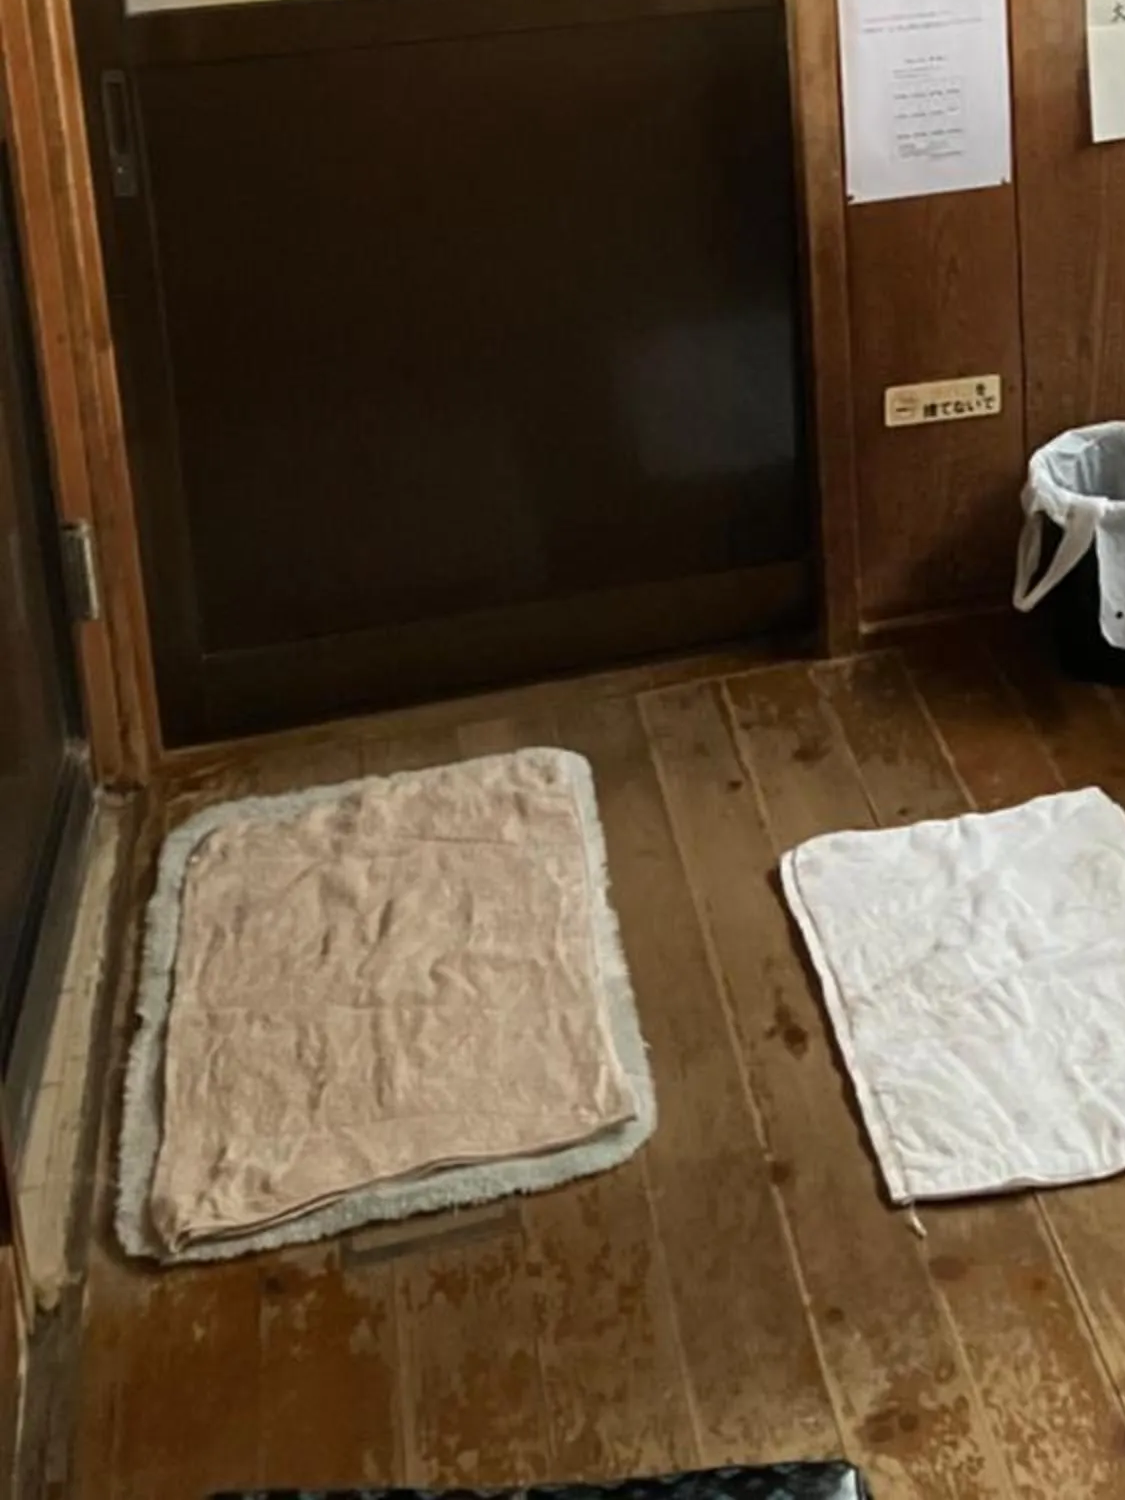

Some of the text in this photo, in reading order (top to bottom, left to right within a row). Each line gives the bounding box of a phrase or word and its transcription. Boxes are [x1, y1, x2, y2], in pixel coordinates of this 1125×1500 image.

[922, 396, 996, 418] 捨てないで
